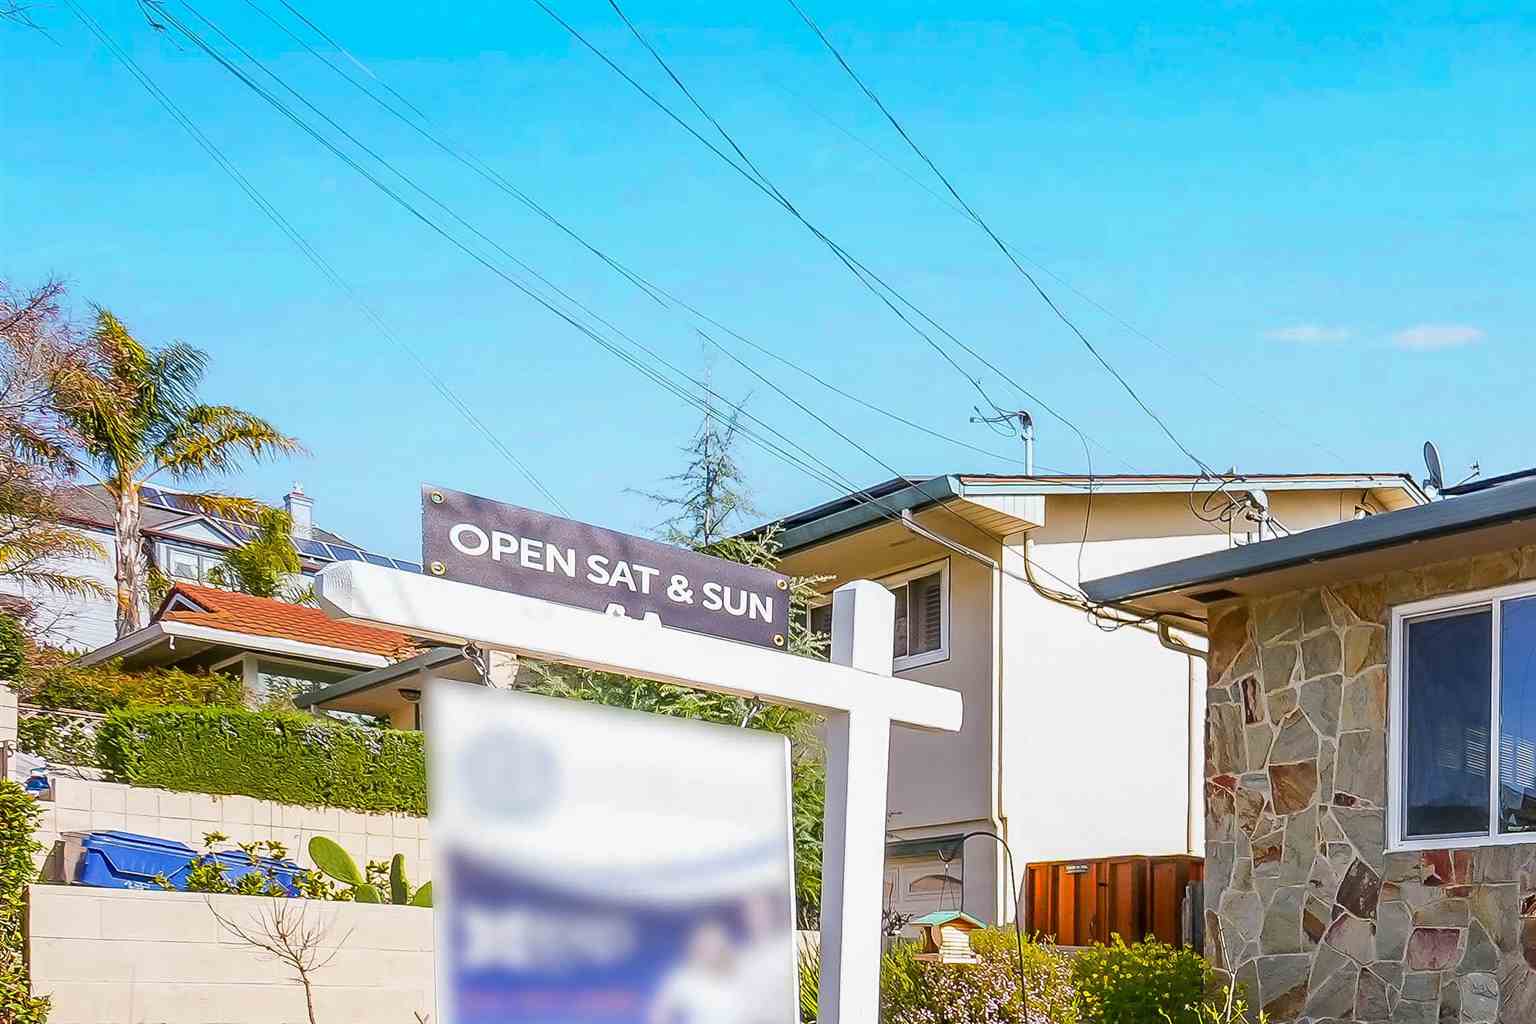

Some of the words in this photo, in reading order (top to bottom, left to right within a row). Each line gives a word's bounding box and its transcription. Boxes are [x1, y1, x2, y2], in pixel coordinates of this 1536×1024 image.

[448, 523, 576, 578] OPEN
[586, 554, 660, 595] SAT
[666, 574, 694, 604] &
[702, 582, 773, 623] SUN
